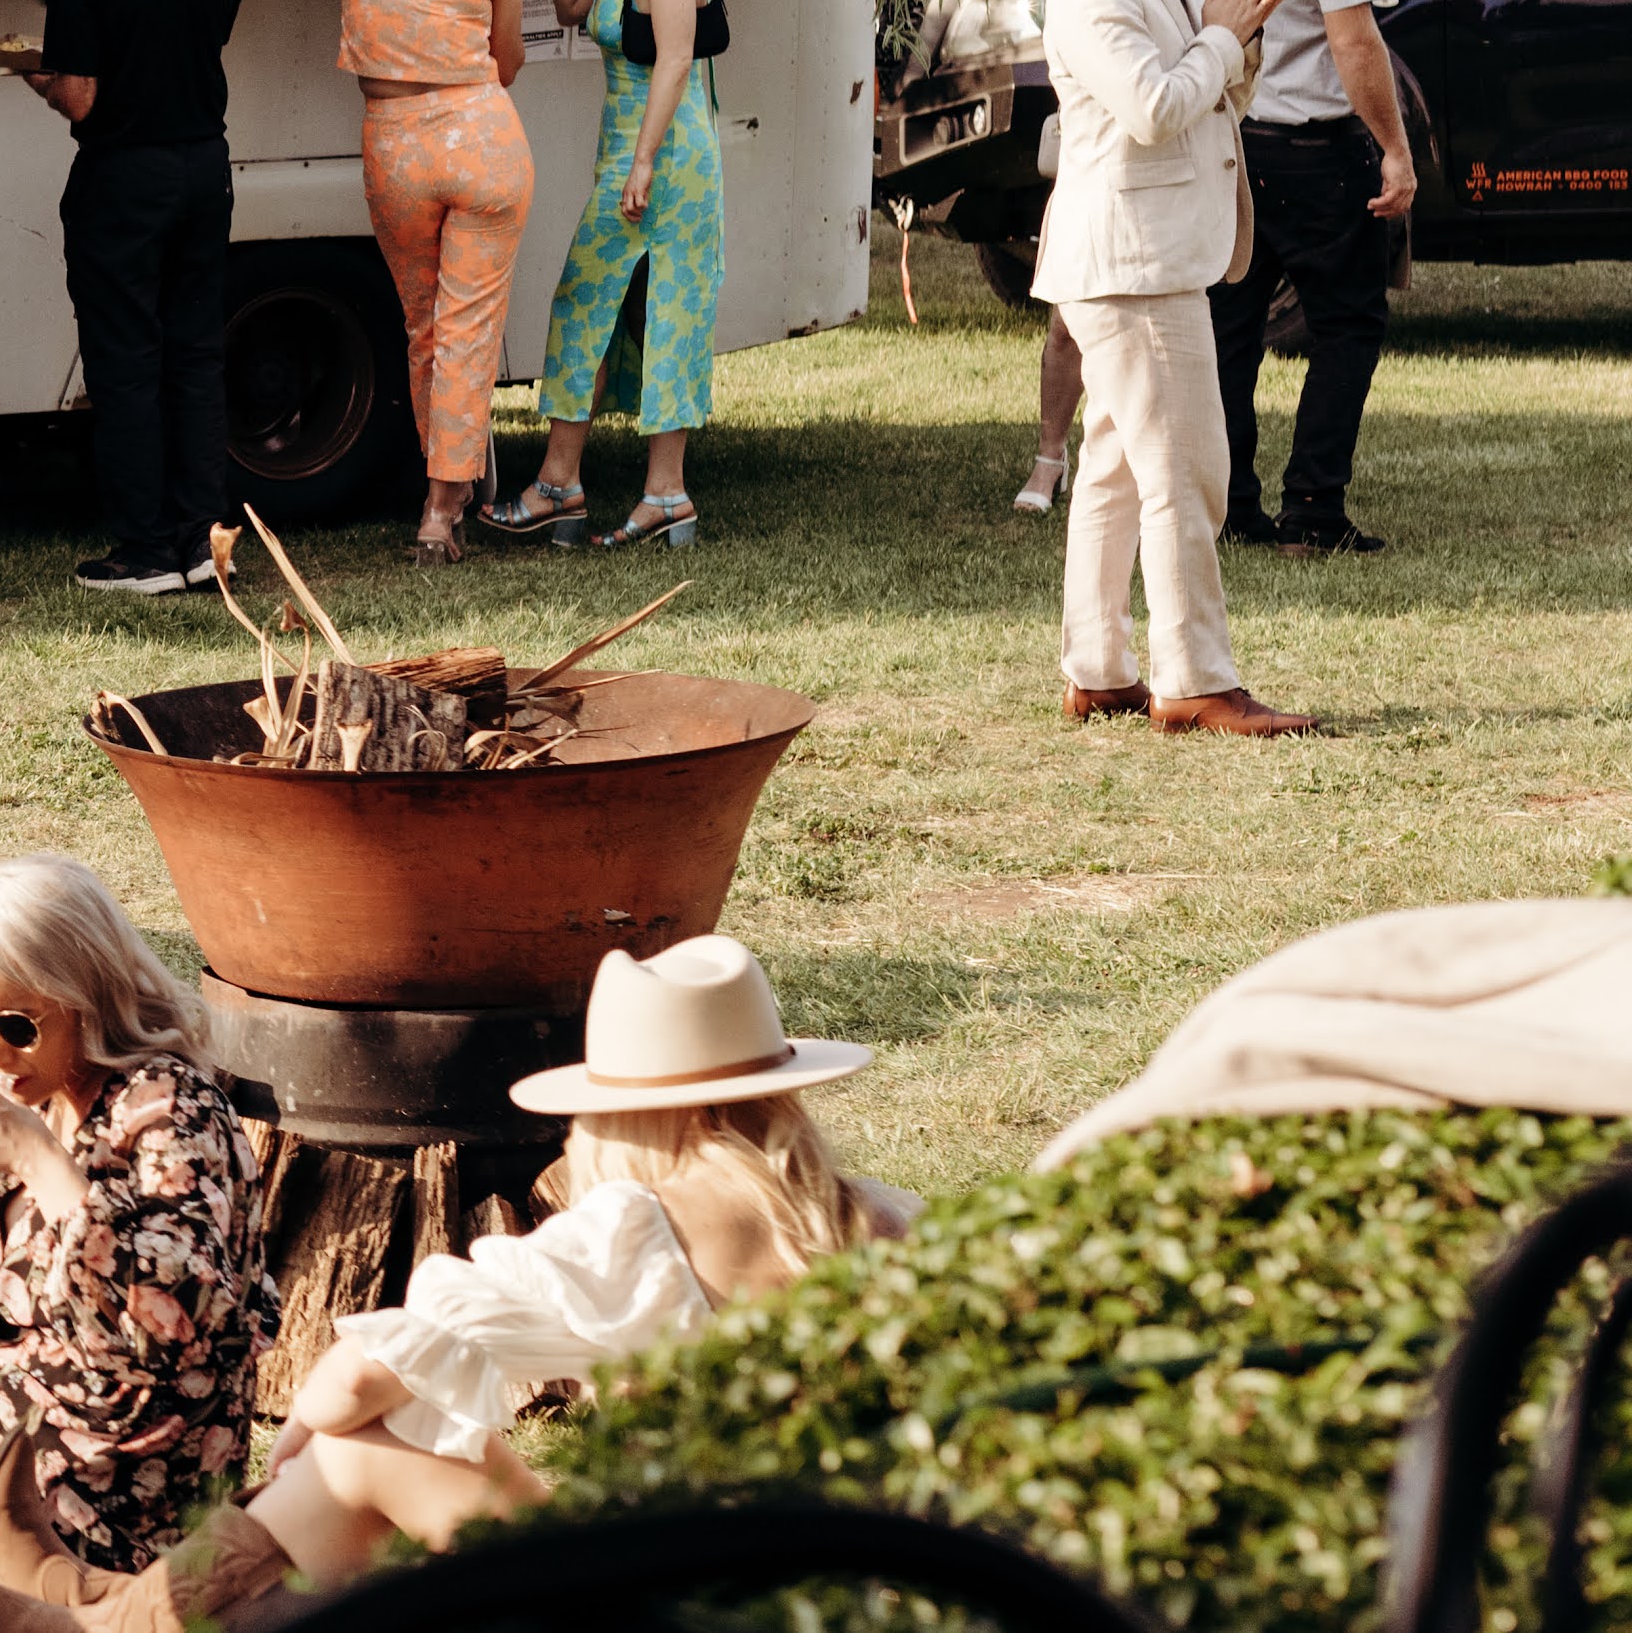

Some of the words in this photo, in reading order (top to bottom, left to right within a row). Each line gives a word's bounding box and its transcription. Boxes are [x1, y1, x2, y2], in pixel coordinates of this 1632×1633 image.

[1496, 170, 1562, 181] AMERICAN
[1593, 170, 1629, 180] FOOD
[1466, 178, 1492, 190] WFR
[1496, 182, 1552, 192] HOWRAH
[1569, 181, 1603, 191] 0400
